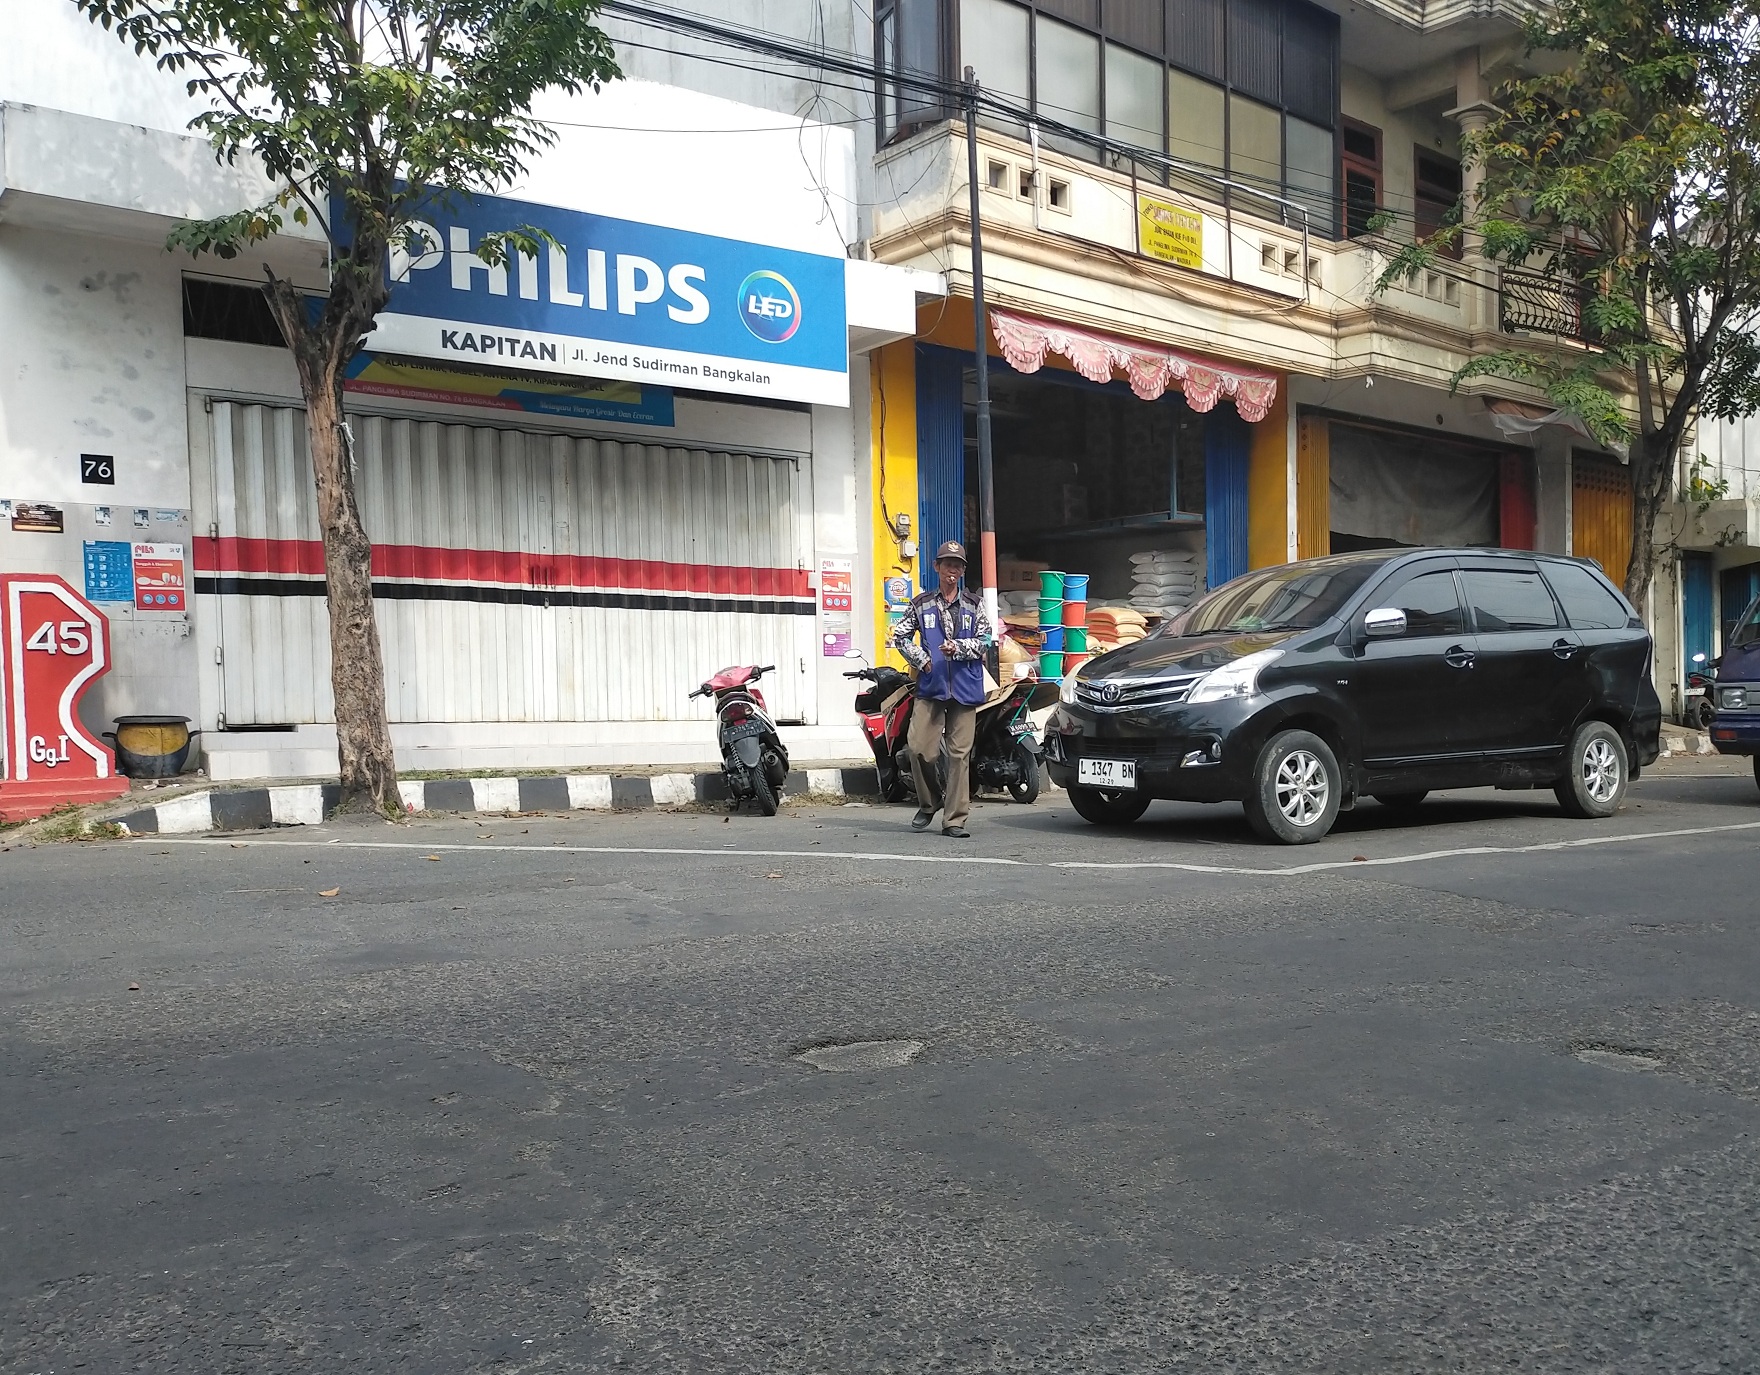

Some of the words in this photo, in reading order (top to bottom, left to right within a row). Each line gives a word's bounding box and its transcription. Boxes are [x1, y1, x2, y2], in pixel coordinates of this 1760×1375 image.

[389, 216, 710, 325] PHILIPS
[747, 293, 793, 319] LED
[441, 329, 557, 363] KAPITAN
[572, 349, 588, 361] Jl.
[593, 351, 628, 367] Jend
[632, 356, 699, 376] Sudirman
[702, 365, 771, 386] Bangkalan
[362, 386, 401, 396] PANGLIMA
[401, 390, 439, 400] SUDIRMAN
[463, 396, 506, 407] BANGKALAN
[84, 460, 112, 478] 76
[26, 621, 90, 655] 45
[1080, 761, 1086, 775] L
[1091, 761, 1113, 777] 1347
[1122, 764, 1134, 779] BN
